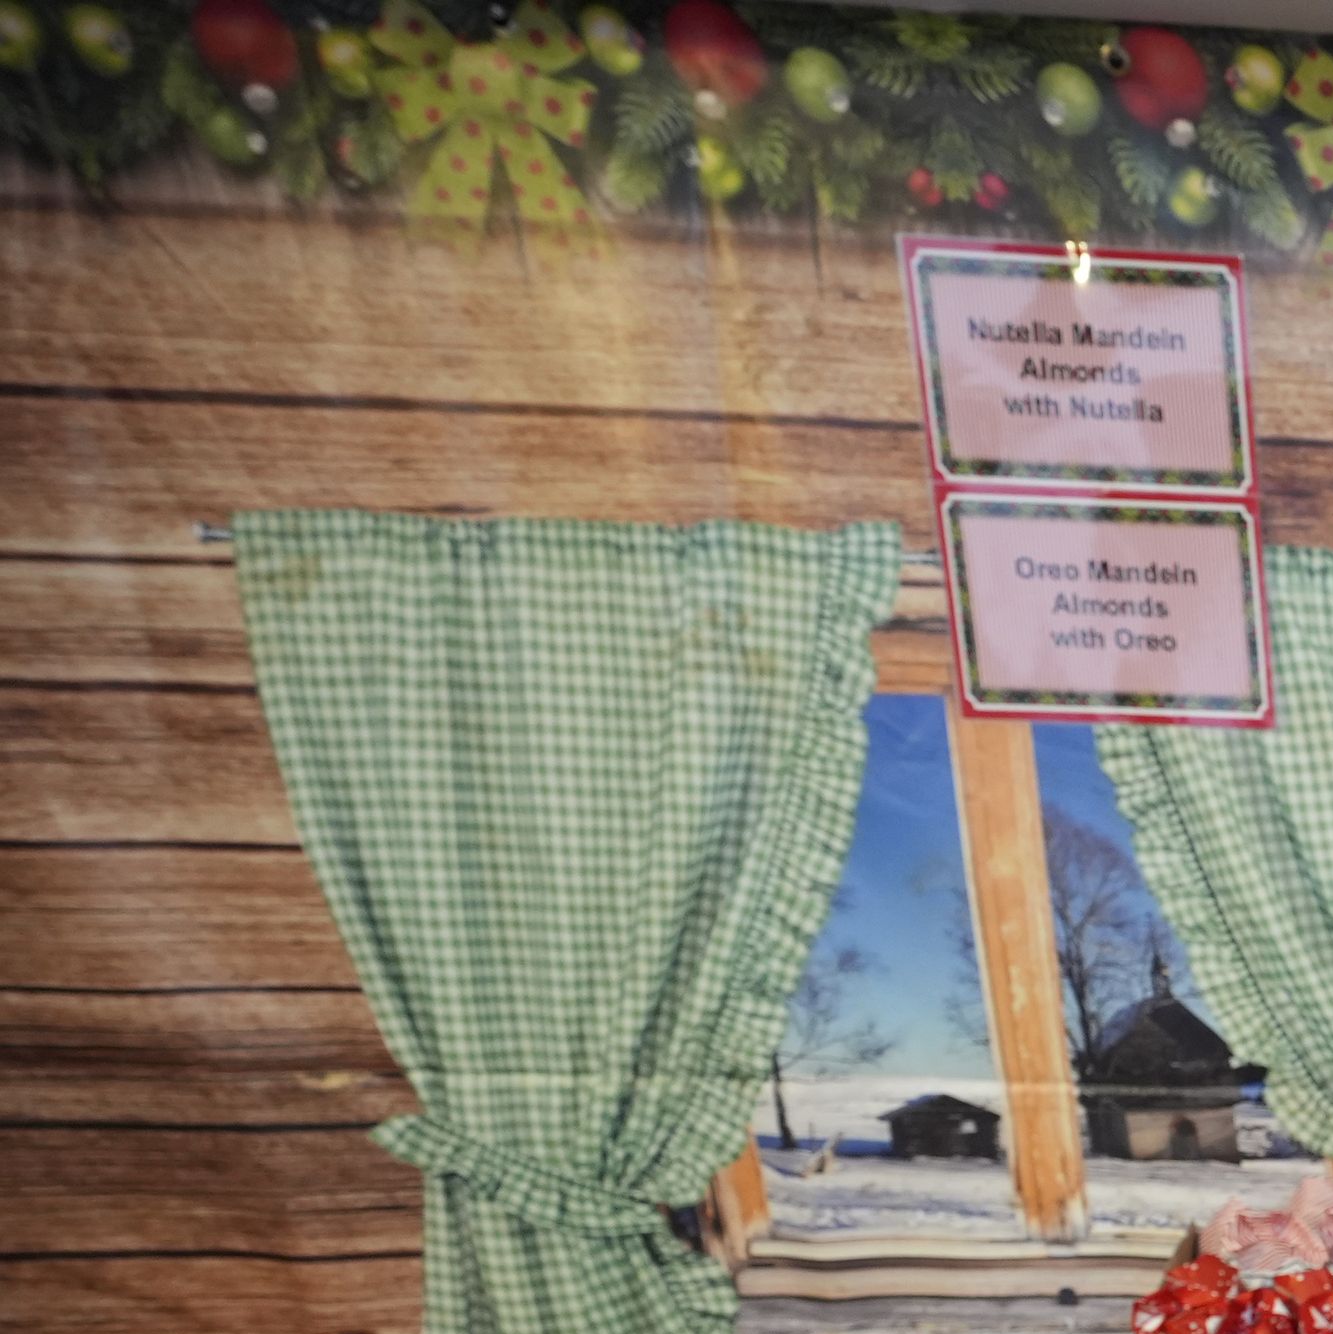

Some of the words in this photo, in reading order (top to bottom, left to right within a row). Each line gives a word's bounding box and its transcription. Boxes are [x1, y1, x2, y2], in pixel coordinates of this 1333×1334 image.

[967, 316, 1062, 345] Nutella
[1072, 321, 1187, 351] Mandeln
[1020, 356, 1141, 384] Almonds
[1002, 393, 1060, 418] with
[1069, 396, 1163, 423] Nutella
[1015, 556, 1079, 581] Oreo
[1088, 559, 1198, 585] Mandeln
[1053, 591, 1169, 618] Almonds
[1051, 626, 1105, 649] with
[1114, 627, 1177, 652] Oreo
